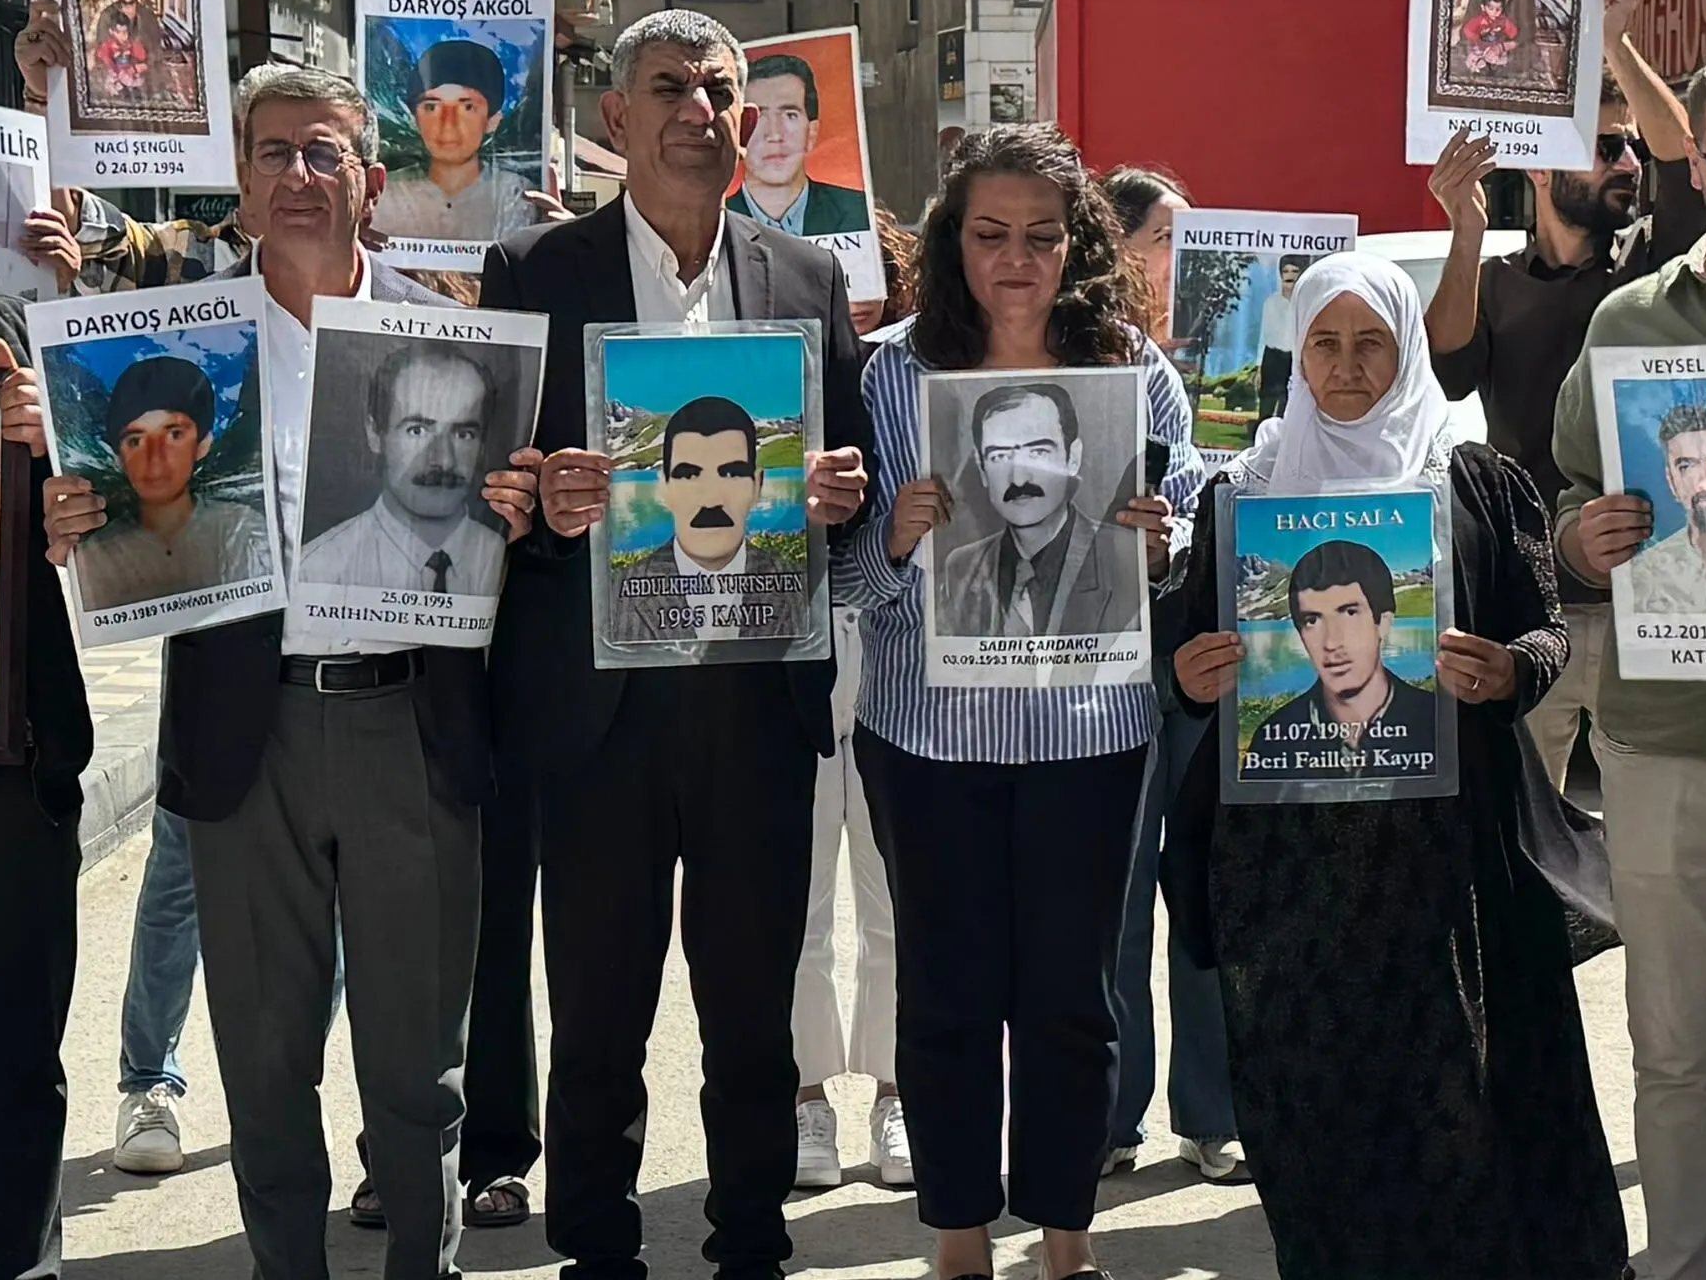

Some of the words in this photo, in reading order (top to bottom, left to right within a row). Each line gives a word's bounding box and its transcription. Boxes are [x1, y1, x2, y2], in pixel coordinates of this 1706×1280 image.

[93, 139, 130, 155] NACİ
[132, 138, 186, 156] ŞENGÜL
[1491, 141, 1539, 156] 7.1994
[1184, 229, 1275, 249] NURETTİN
[1279, 233, 1349, 251] TURGUT
[65, 306, 162, 339] DARYOŞ
[167, 296, 242, 328] AKGÖL
[379, 316, 431, 338] SAİT
[436, 322, 493, 341] AKIN
[1641, 358, 1705, 375] VEYSEL
[713, 570, 804, 595] YURTSEVEN
[380, 590, 454, 609] 25.09.1995
[304, 603, 410, 625] TARİHİNDE
[656, 604, 705, 630] 1995
[711, 603, 775, 628] KAYIP
[1243, 750, 1288, 770] Beri
[1293, 750, 1367, 771] Failleri
[1372, 748, 1435, 773] Kayıp
